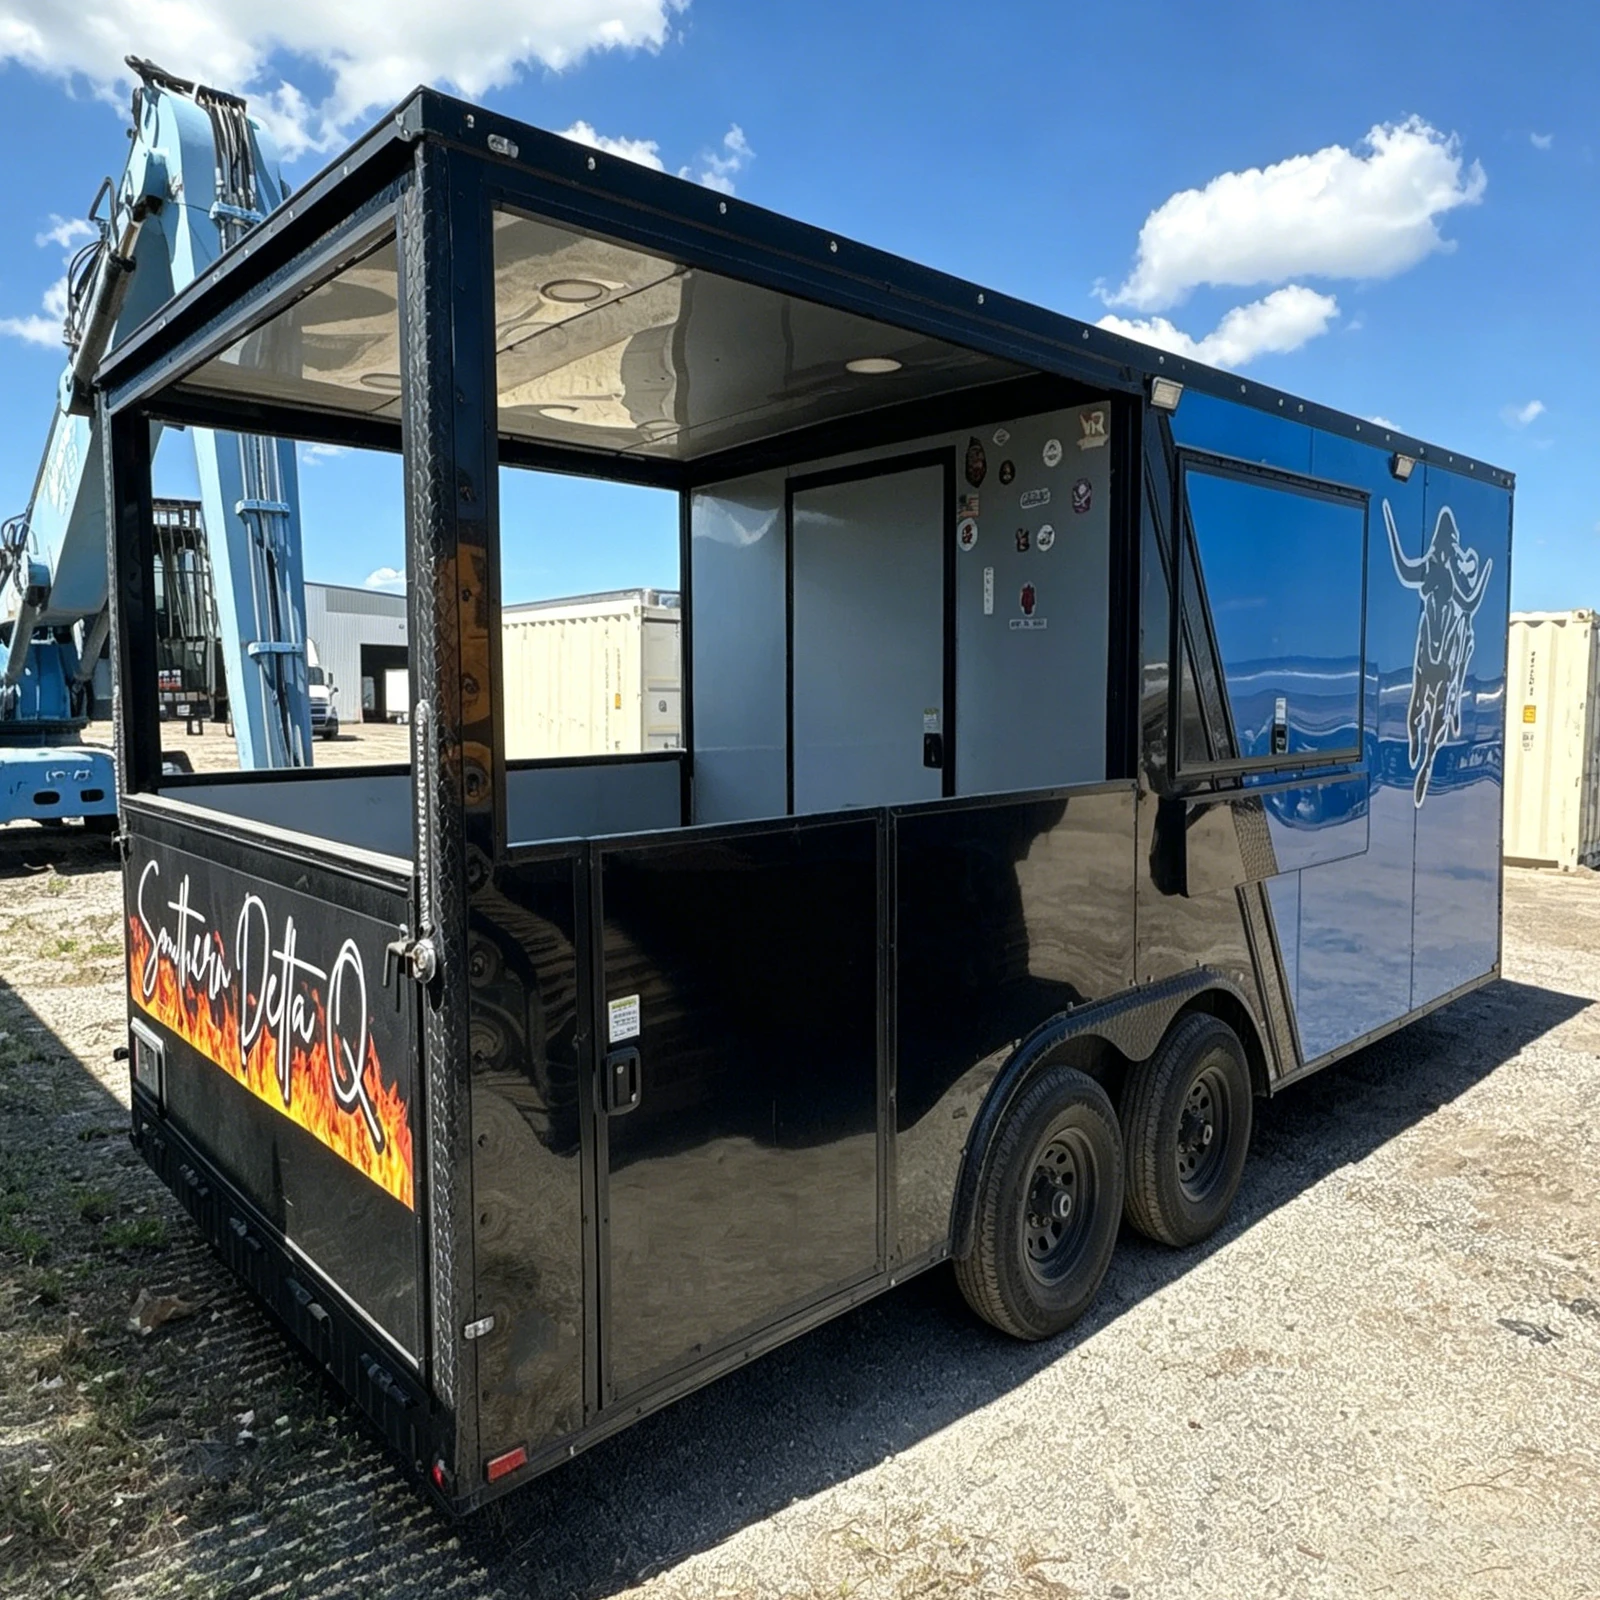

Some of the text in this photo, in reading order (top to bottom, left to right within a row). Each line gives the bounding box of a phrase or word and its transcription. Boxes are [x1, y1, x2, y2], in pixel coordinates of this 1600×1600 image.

[137, 859, 382, 1143] Southern Delta Q
